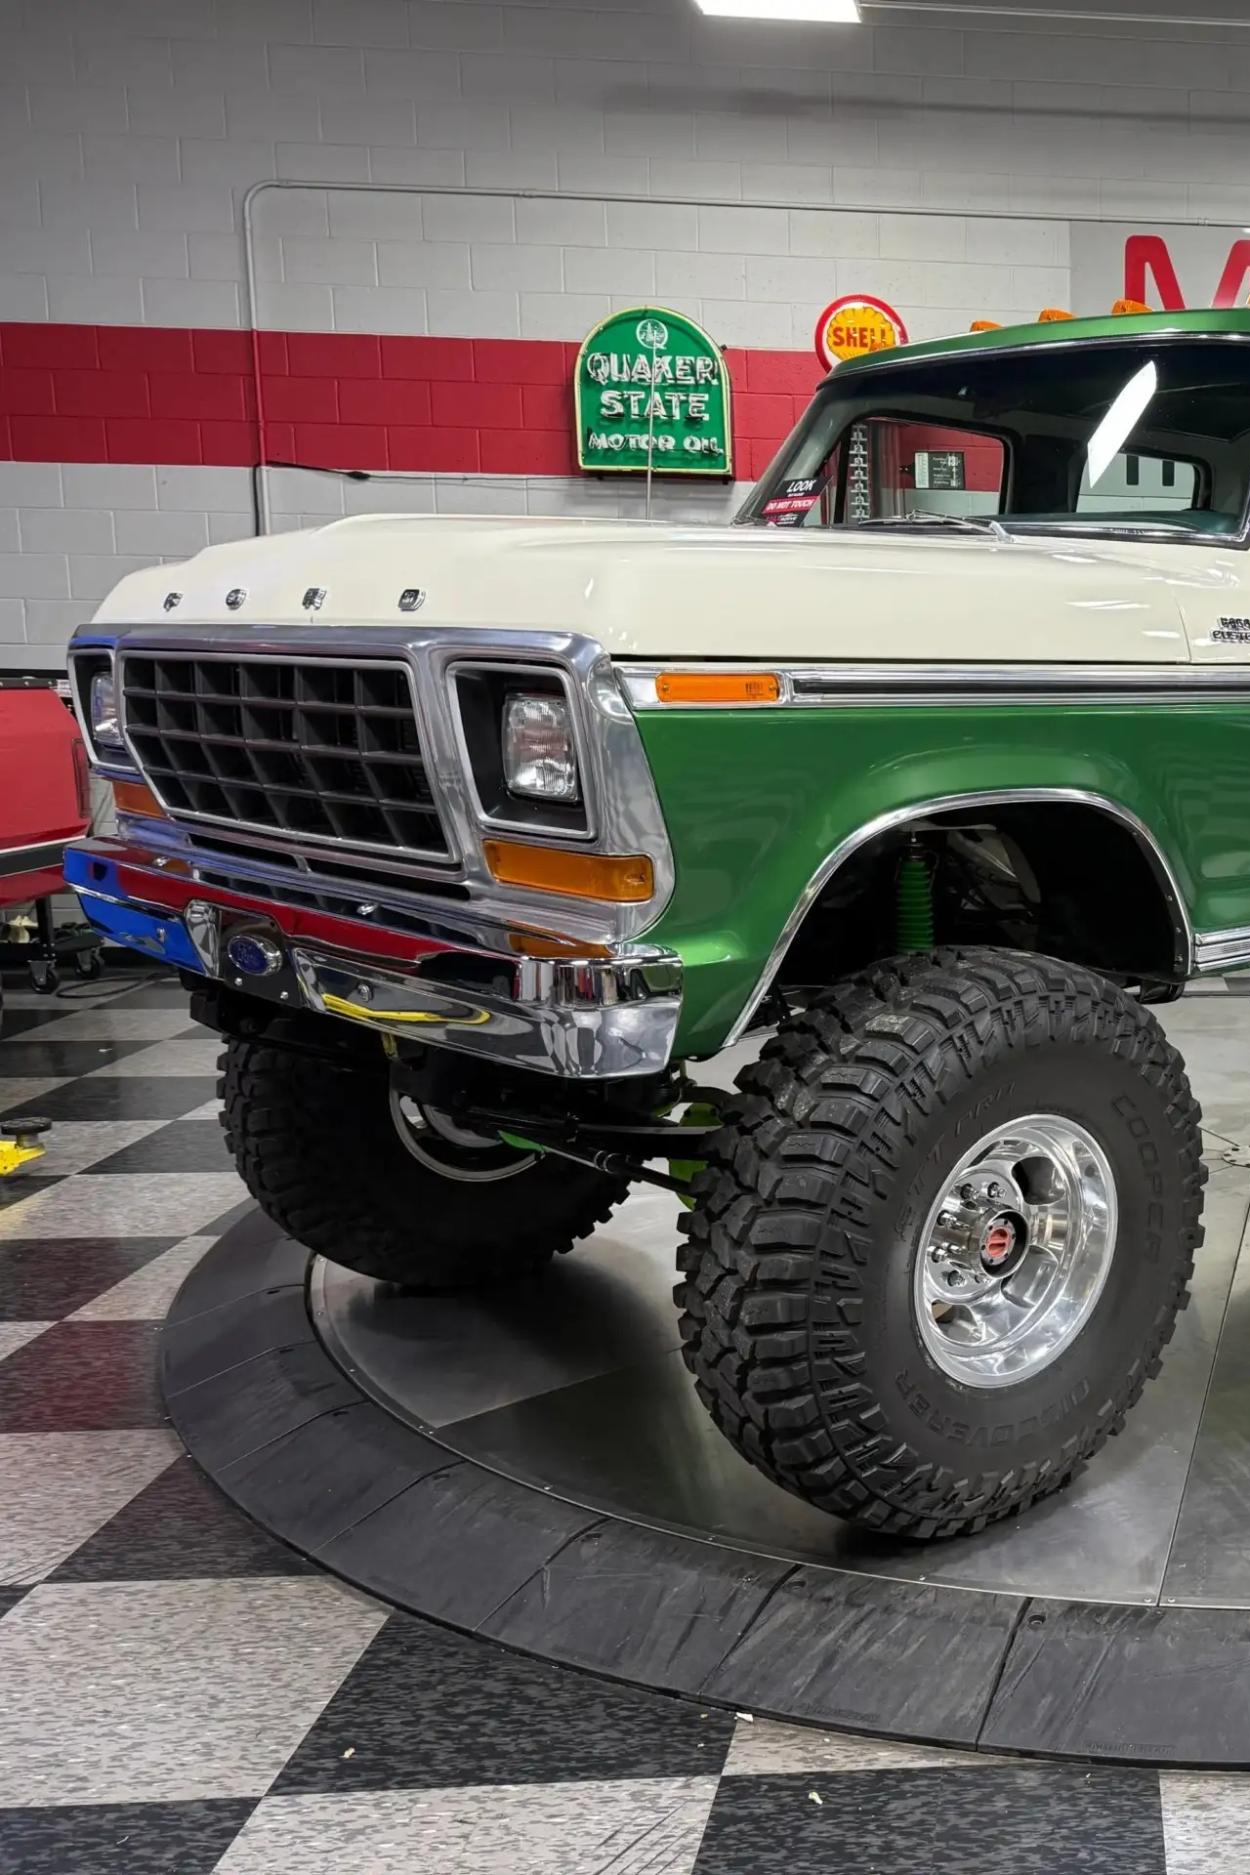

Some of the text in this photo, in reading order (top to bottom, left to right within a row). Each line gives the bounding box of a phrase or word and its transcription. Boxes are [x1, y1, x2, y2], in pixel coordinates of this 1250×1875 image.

[587, 353, 720, 386] QUAKER
[600, 390, 710, 420] STATE
[588, 432, 724, 456] MOTOR OIL
[786, 479, 817, 493] LOOK
